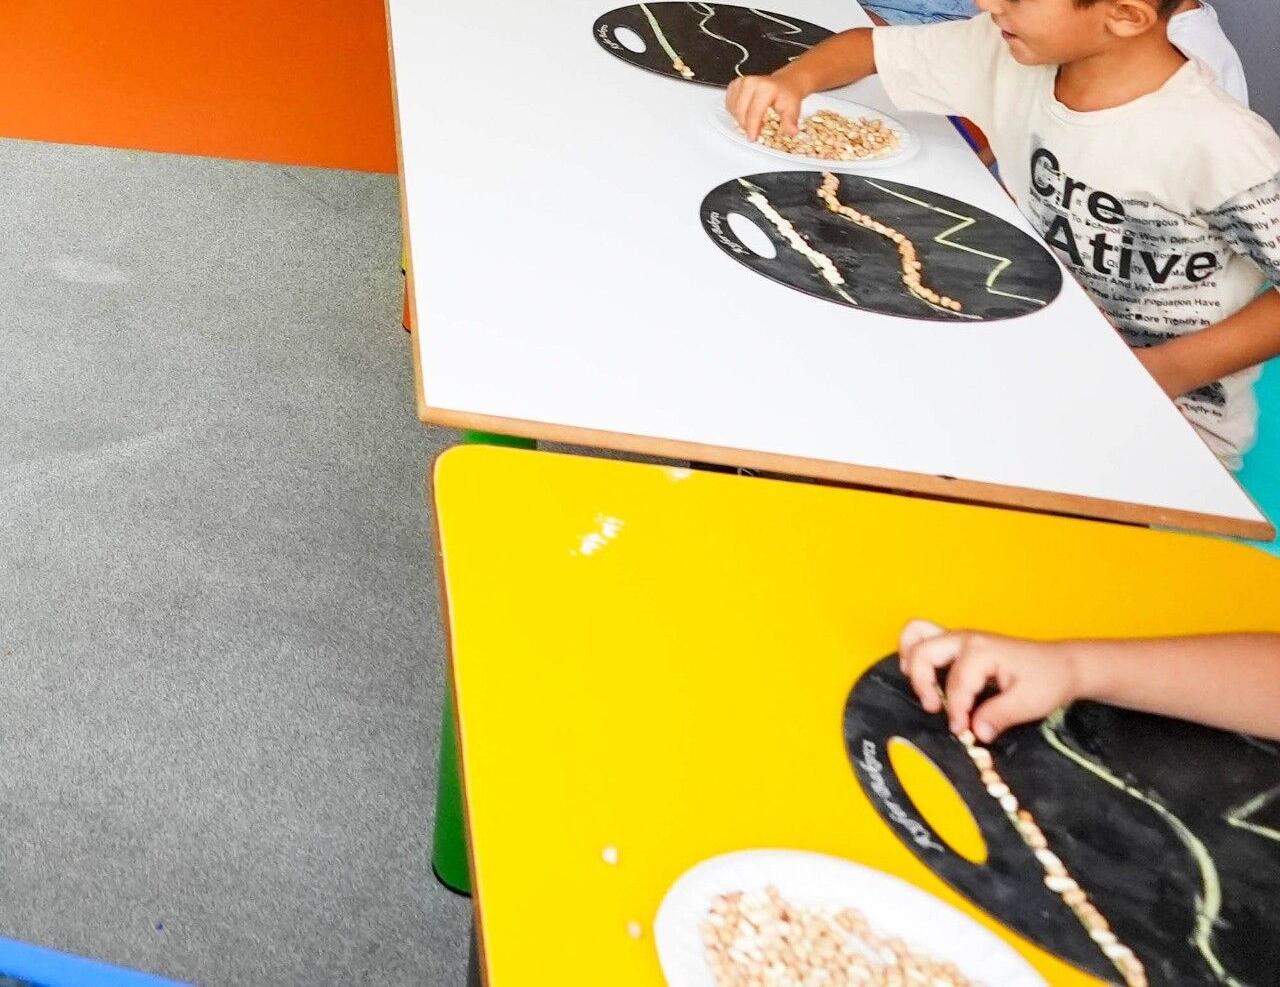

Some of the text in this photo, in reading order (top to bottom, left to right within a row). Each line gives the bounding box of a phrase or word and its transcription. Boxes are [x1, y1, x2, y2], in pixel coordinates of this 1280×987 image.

[1030, 147, 1125, 225] Cre
[1044, 214, 1217, 283] Ative
[1194, 298, 1220, 308] Have
